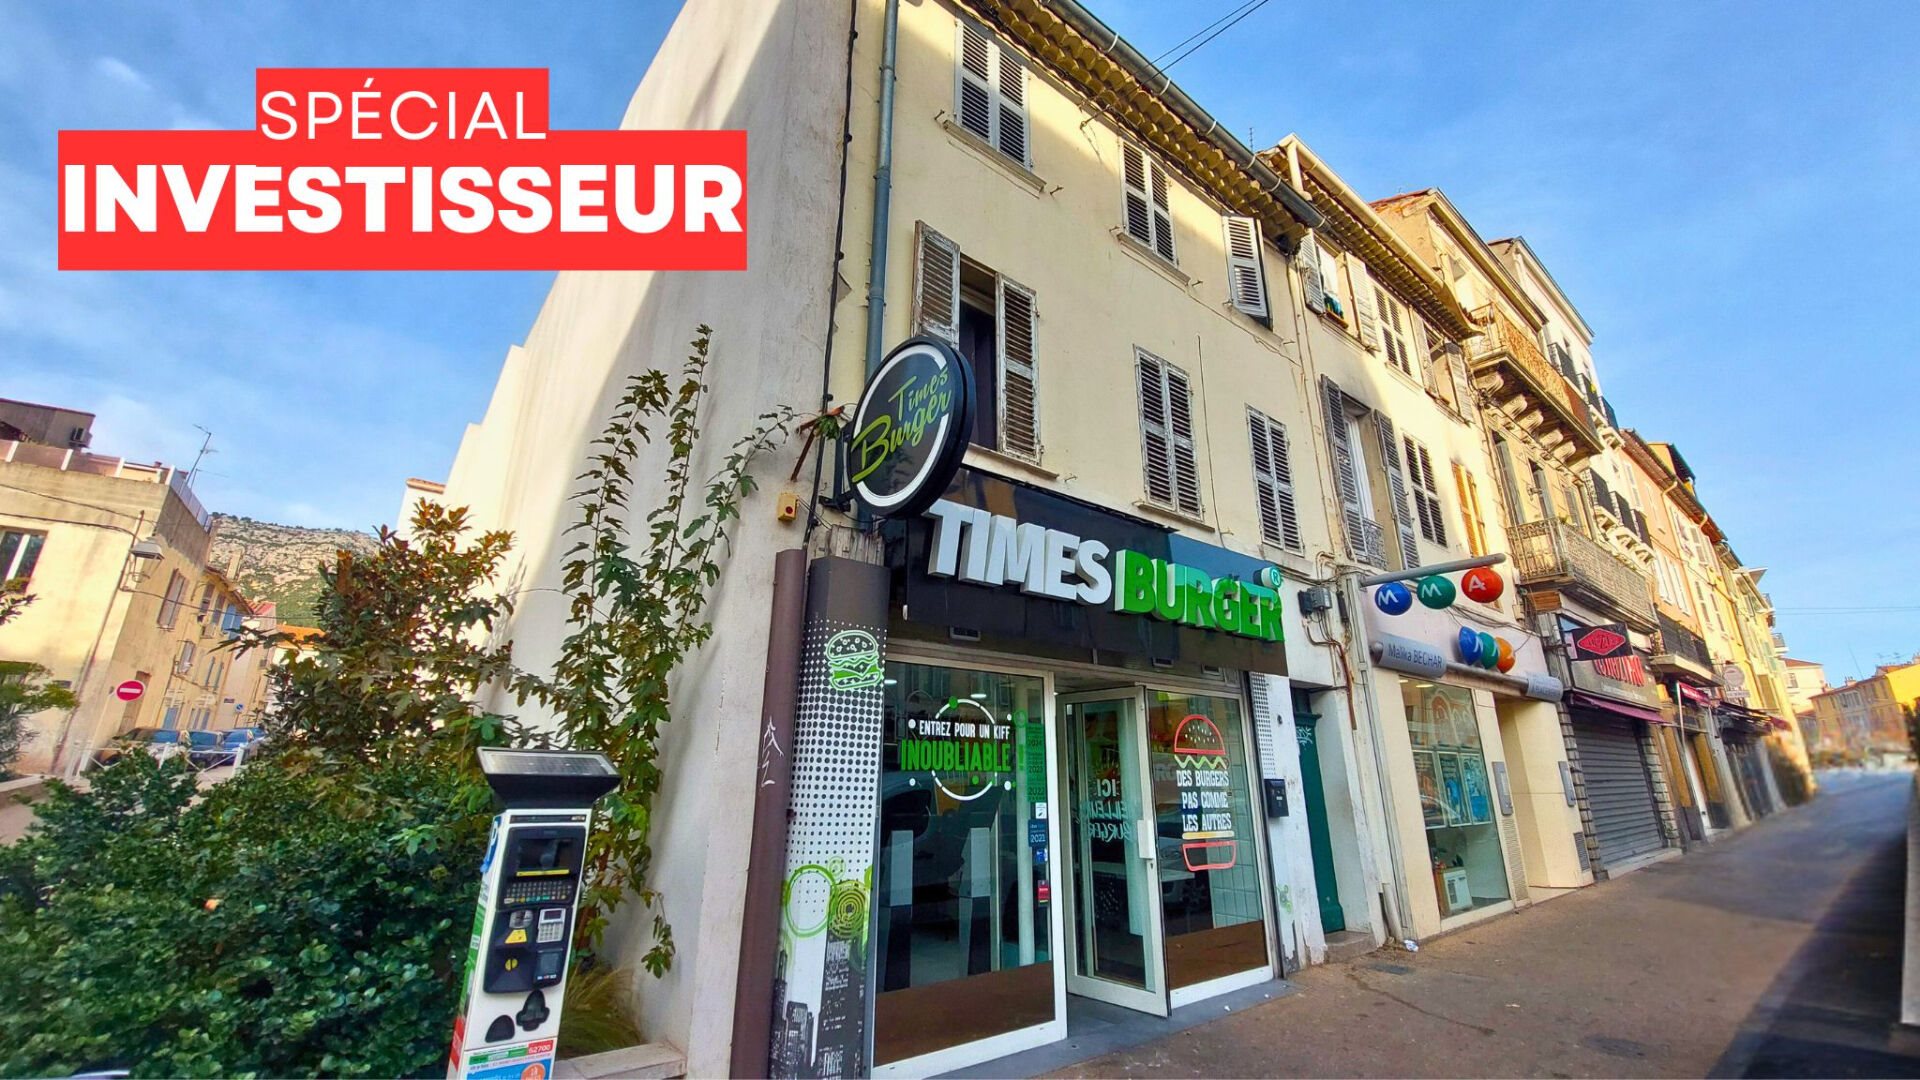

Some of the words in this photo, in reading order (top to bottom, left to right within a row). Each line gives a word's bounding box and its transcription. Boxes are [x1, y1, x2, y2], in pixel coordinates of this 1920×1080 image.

[888, 366, 949, 421] Times
[850, 390, 952, 483] Burger
[922, 499, 1113, 605] TIMES
[1115, 549, 1286, 642] BURGER
[1378, 589, 1399, 606] M
[1421, 583, 1442, 599] M
[919, 720, 951, 737] ENTREZ
[954, 722, 976, 738] POUR
[979, 724, 990, 739] UN
[993, 725, 1011, 740] KIFF
[901, 739, 1012, 772] INOUBLIABLE
[1176, 769, 1193, 787] DES
[1194, 769, 1230, 787] BURGERS
[1181, 791, 1199, 809] PAS
[1200, 791, 1229, 809] COMME
[1182, 813, 1199, 832] LES
[1201, 812, 1232, 831] AUTRES
